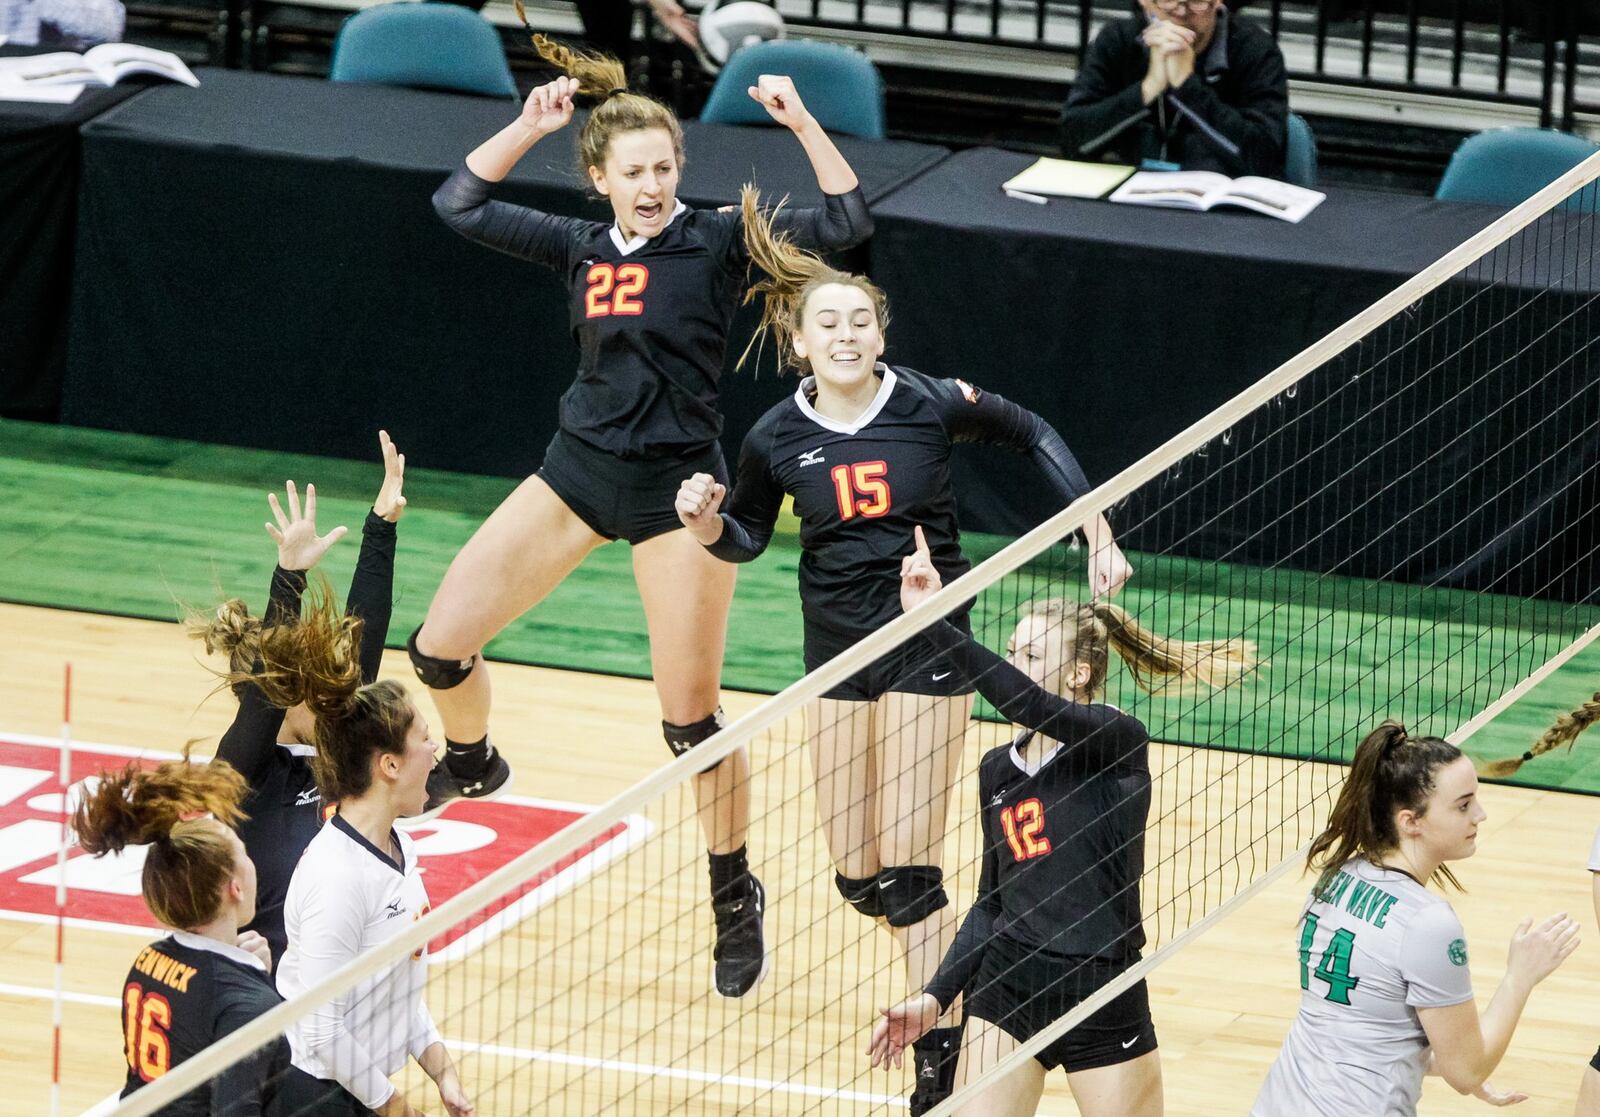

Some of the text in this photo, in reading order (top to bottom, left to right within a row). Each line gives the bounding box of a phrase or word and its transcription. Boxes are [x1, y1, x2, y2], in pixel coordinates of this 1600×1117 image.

[584, 262, 650, 319] 22
[831, 460, 892, 521] 15
[1000, 797, 1052, 862] 12
[1345, 879, 1399, 930] WAVE
[1299, 911, 1360, 1006] 14
[125, 982, 172, 1083] 16
